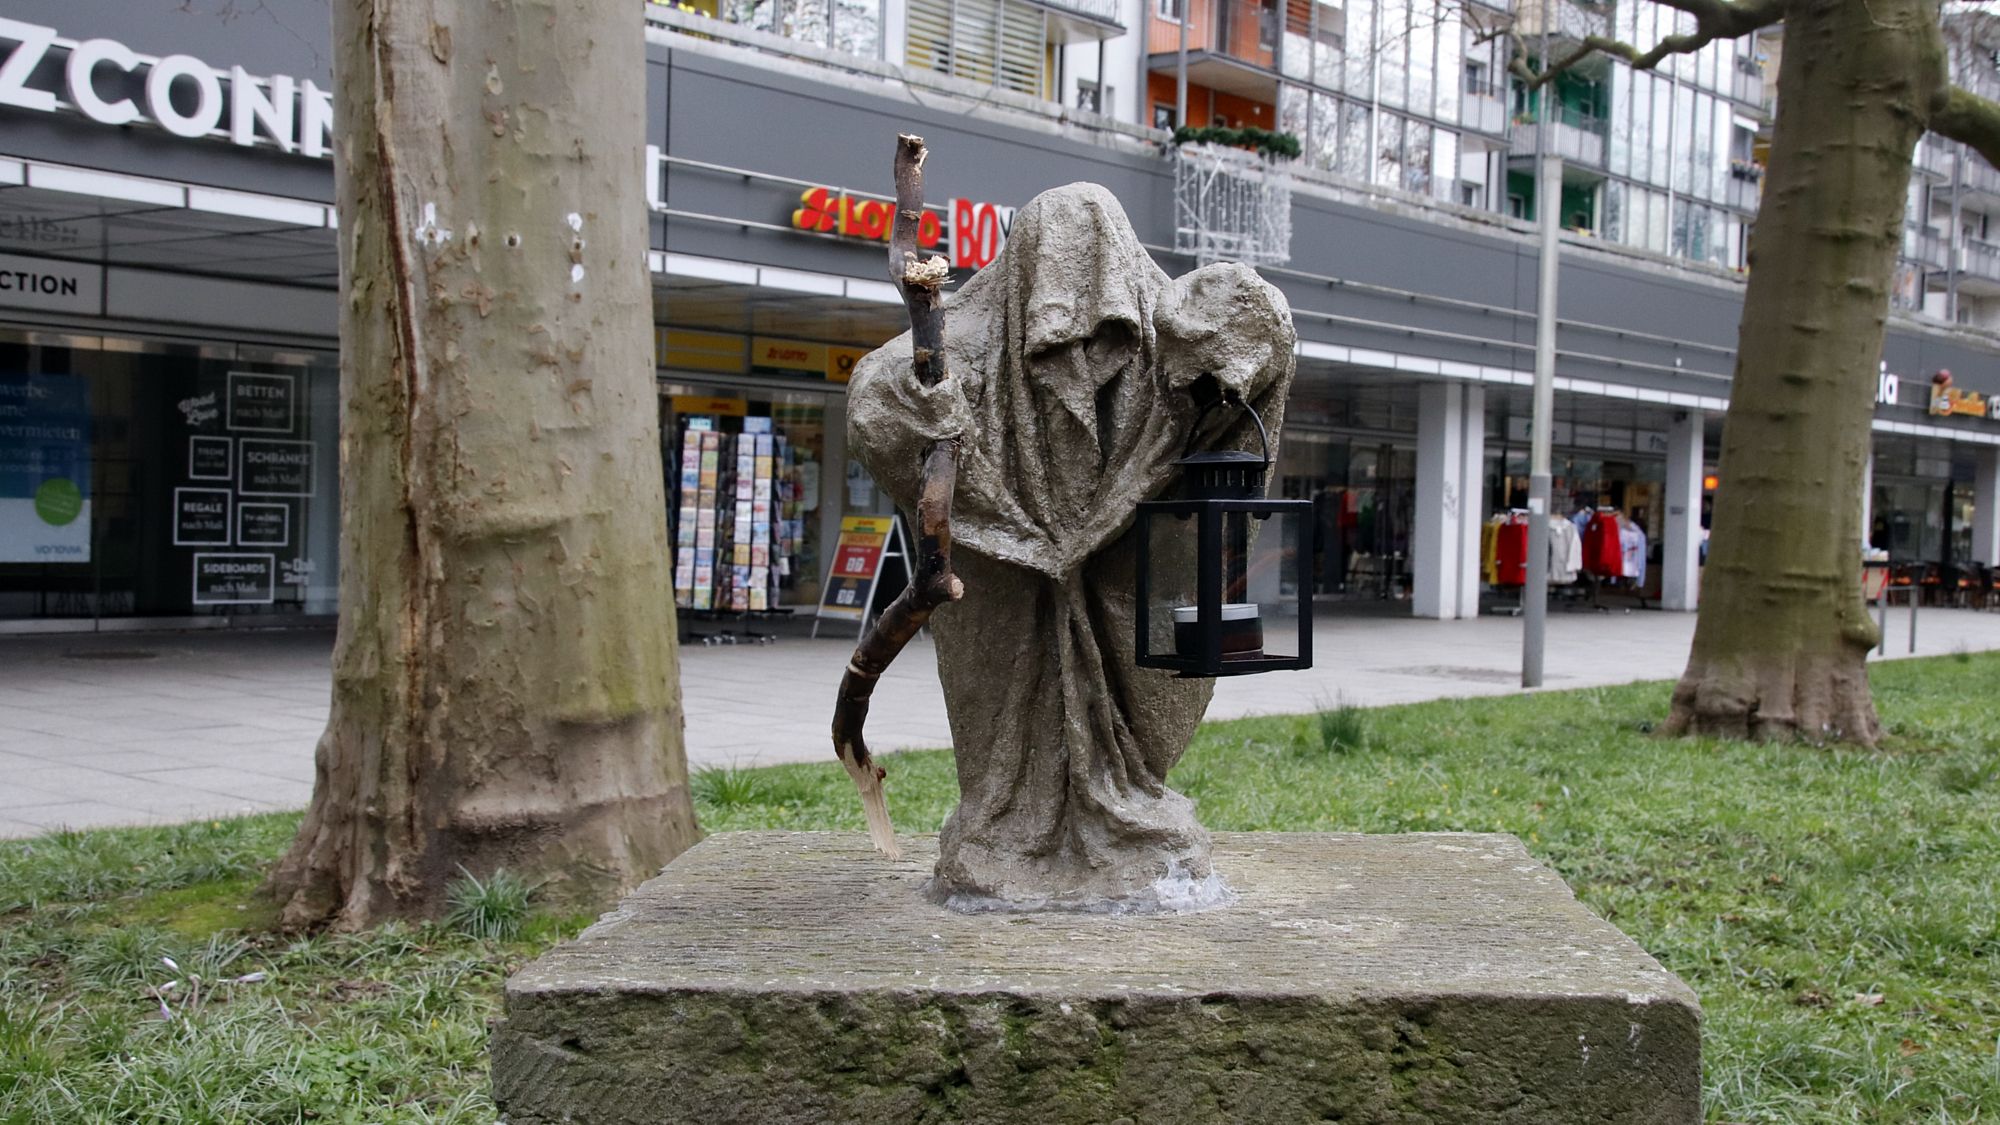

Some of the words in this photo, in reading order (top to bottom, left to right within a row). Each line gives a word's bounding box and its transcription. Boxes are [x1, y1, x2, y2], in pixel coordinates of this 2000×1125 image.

[839, 196, 941, 248] LOO
[0, 270, 77, 296] CTION
[237, 385, 285, 398] BETTEN
[183, 502, 223, 513] REGALE
[203, 563, 266, 574] SIDEBOARDS
